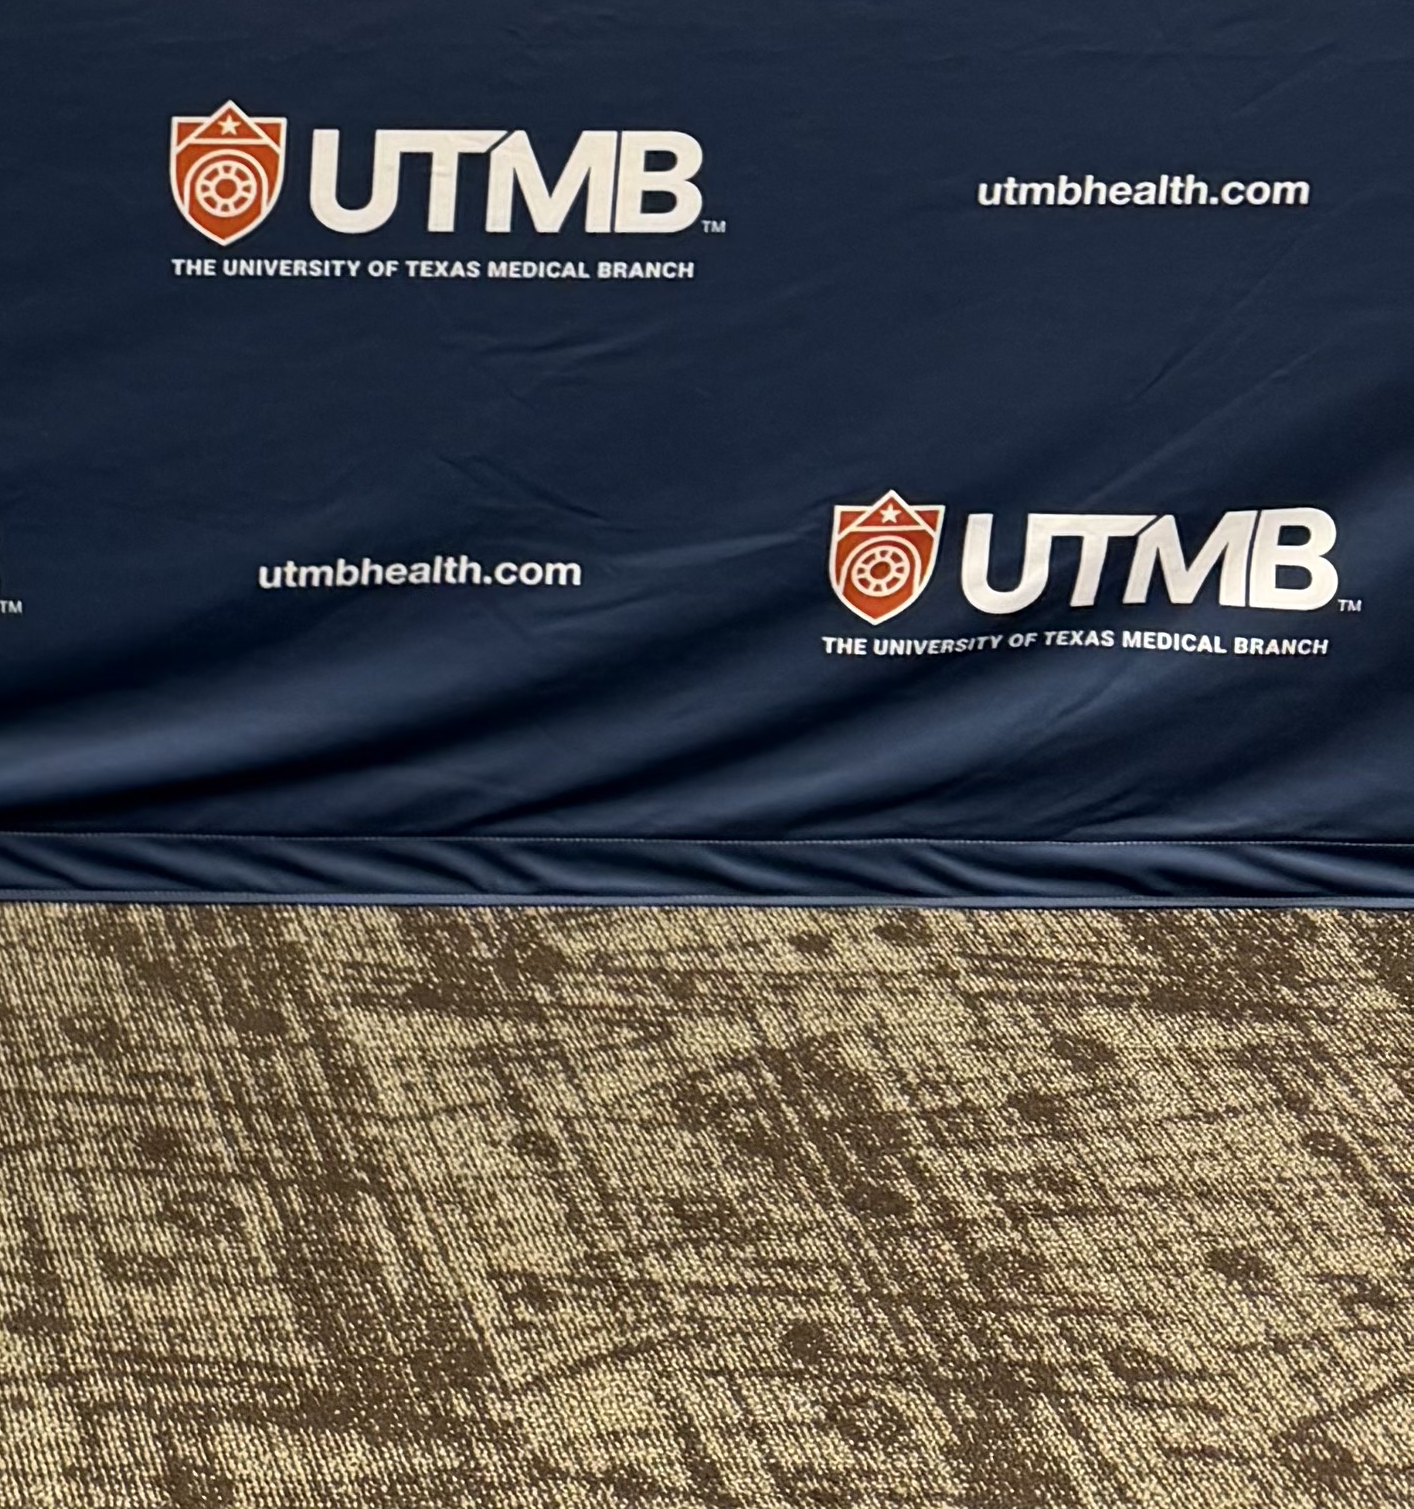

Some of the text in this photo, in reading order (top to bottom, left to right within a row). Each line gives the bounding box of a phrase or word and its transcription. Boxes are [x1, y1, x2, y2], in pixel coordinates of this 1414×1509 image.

[310, 129, 702, 233] UTMB
[978, 173, 1310, 206] utmbhealth.com
[171, 258, 695, 279] THE UNIVERSITY OF TEXAS MEDICAL BRANCH
[259, 554, 582, 589] utmbhealth.com
[962, 508, 1338, 614] UTMB
[821, 629, 1329, 656] THE UNIVERSITY OF TEXAS MEDICAL BRANCH
